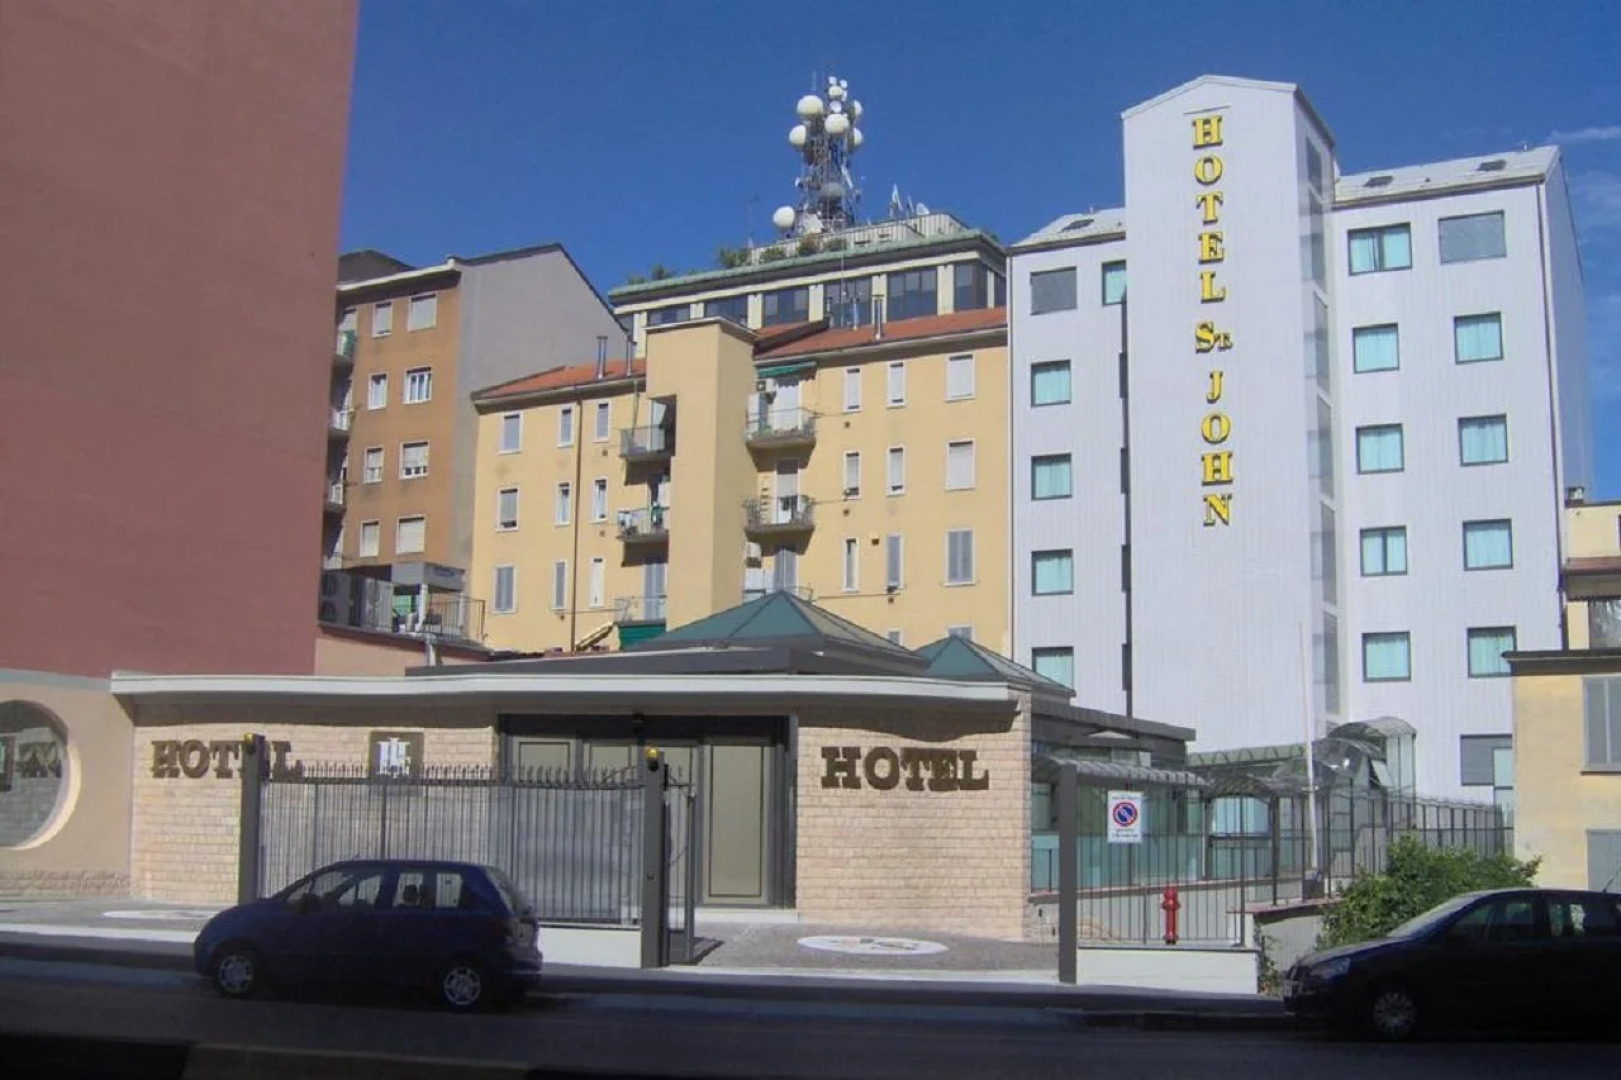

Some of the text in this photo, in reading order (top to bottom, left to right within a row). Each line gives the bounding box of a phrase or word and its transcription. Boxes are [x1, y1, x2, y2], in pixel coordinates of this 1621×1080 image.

[1193, 116, 1226, 304] HOTEL
[1201, 370, 1232, 527] JOHN
[151, 740, 303, 784] HOTL
[821, 747, 989, 791] HOTEL
